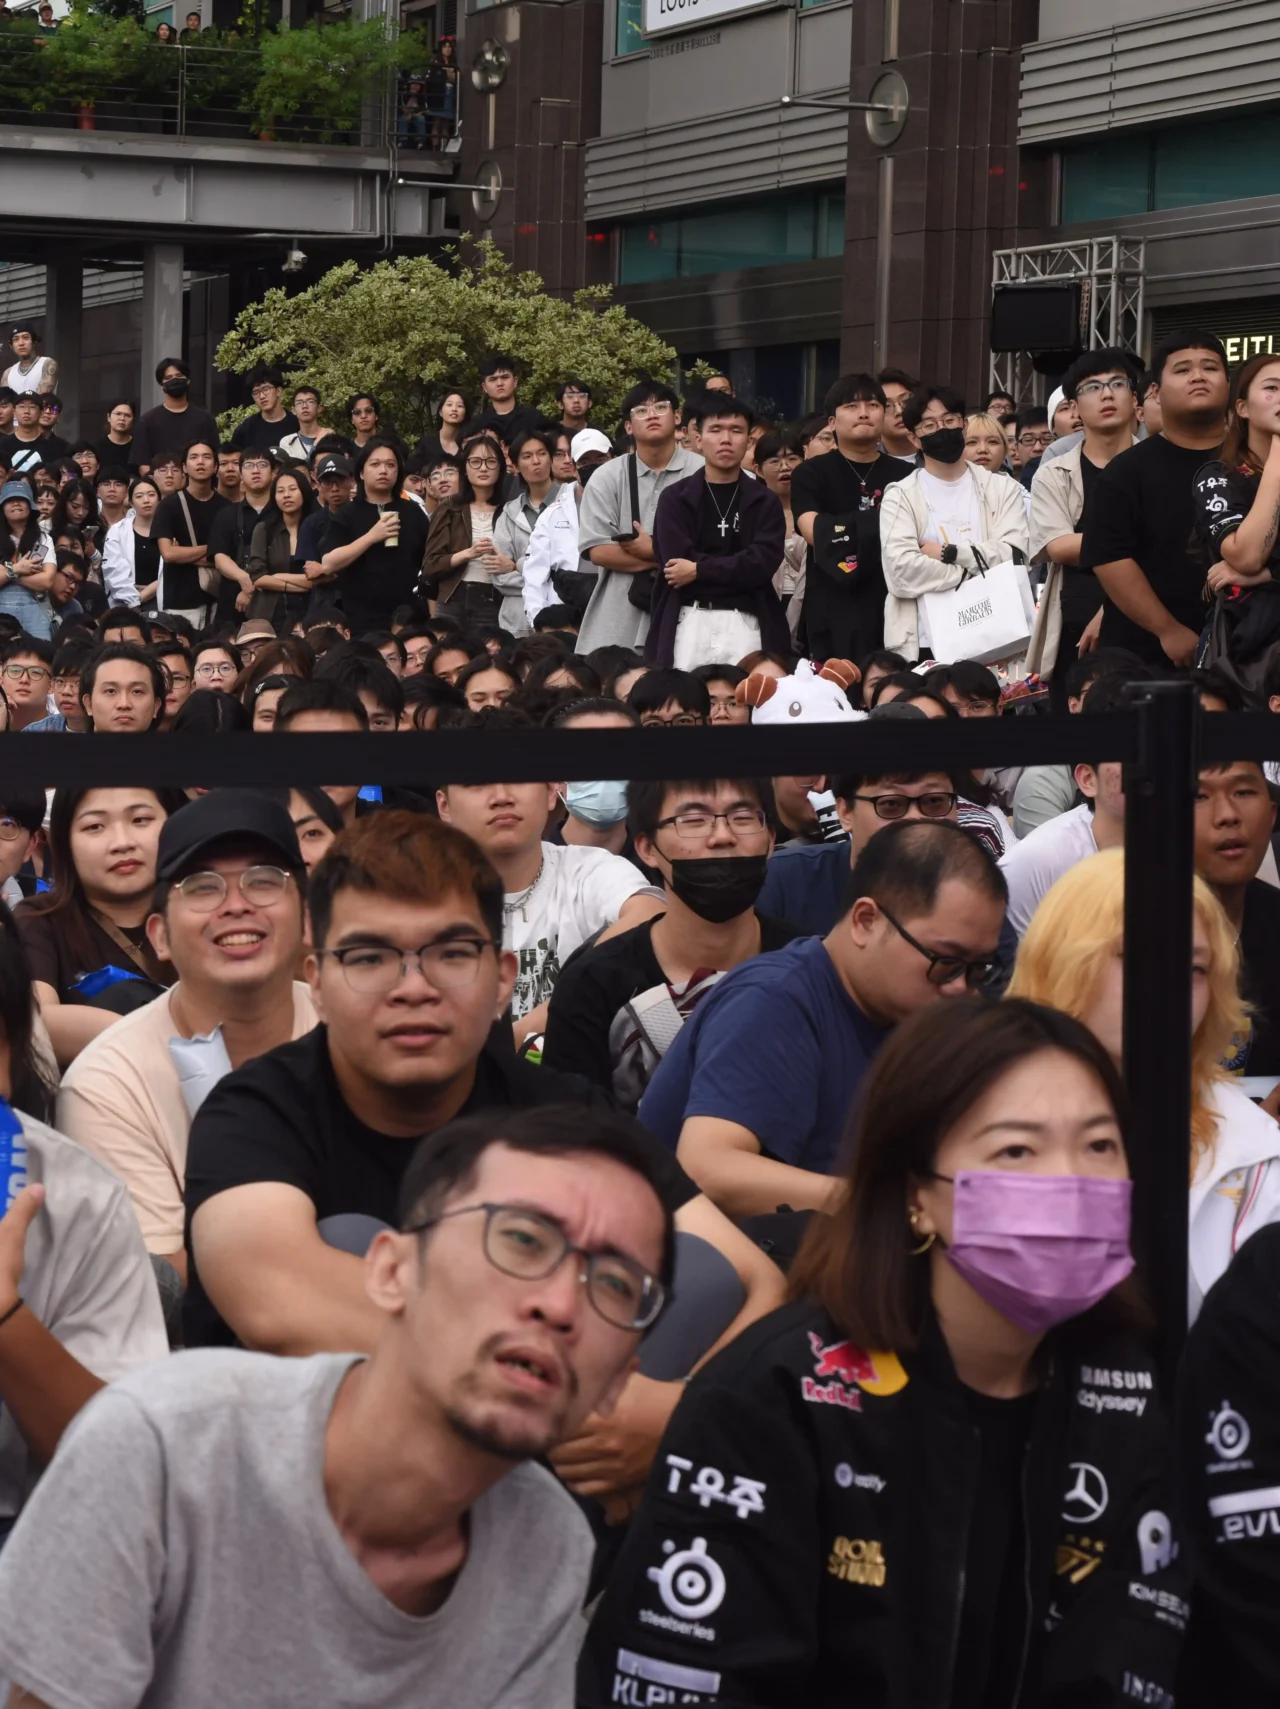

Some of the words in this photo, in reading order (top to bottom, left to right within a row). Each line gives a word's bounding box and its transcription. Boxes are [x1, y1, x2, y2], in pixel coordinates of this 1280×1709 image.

[1076, 1388, 1148, 1417] Odyssey
[666, 1453, 767, 1519] T우주
[638, 1609, 716, 1642] steelseries
